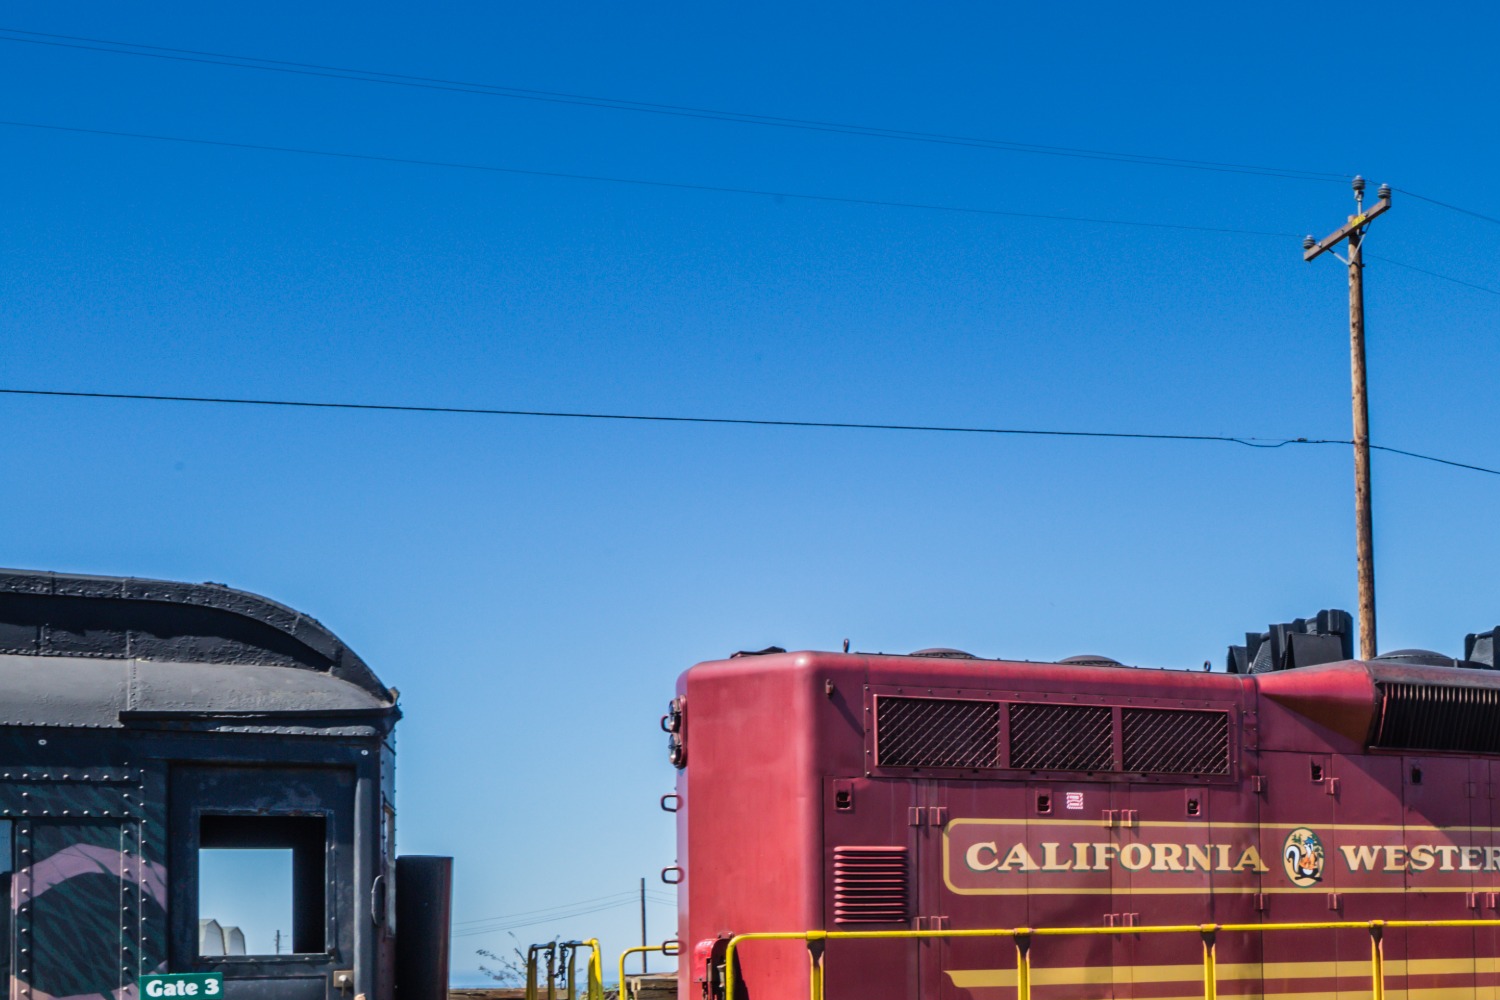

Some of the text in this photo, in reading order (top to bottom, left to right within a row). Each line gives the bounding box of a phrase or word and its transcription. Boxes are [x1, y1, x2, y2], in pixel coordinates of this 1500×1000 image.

[966, 841, 1270, 873] CALIFORNIA
[145, 978, 220, 997] Gate 3
